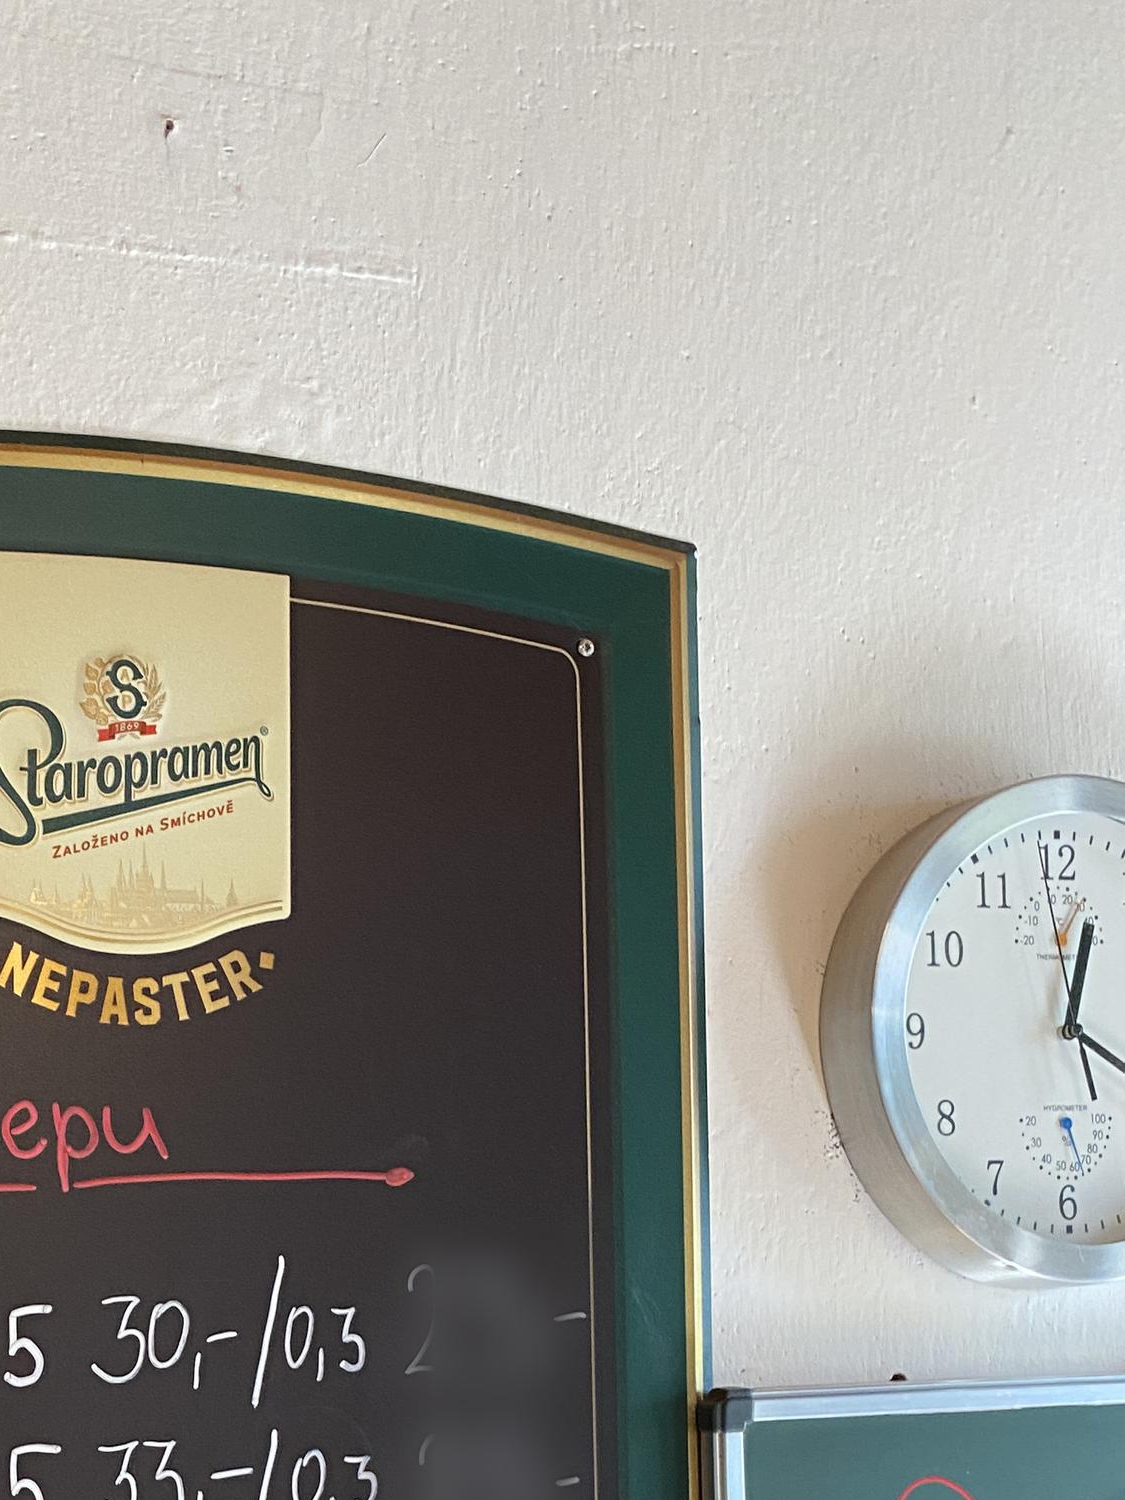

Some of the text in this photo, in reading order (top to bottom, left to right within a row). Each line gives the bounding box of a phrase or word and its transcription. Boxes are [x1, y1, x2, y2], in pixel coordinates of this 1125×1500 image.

[114, 721, 139, 732] 1869
[1038, 843, 1076, 881] 12
[976, 871, 1013, 909] 11
[925, 930, 964, 968] 10
[906, 1013, 926, 1050] 9
[936, 1099, 956, 1136] 8
[1025, 1115, 1037, 1126] 20
[1090, 1113, 1106, 1124] 100
[1092, 1130, 1103, 1140] 90
[1031, 1137, 1042, 1148] 30
[1087, 1143, 1098, 1154] 80
[1041, 1153, 1052, 1164] 40
[1056, 1160, 1067, 1171] 50
[987, 1159, 1005, 1195] 7
[1059, 1184, 1078, 1221] 6
